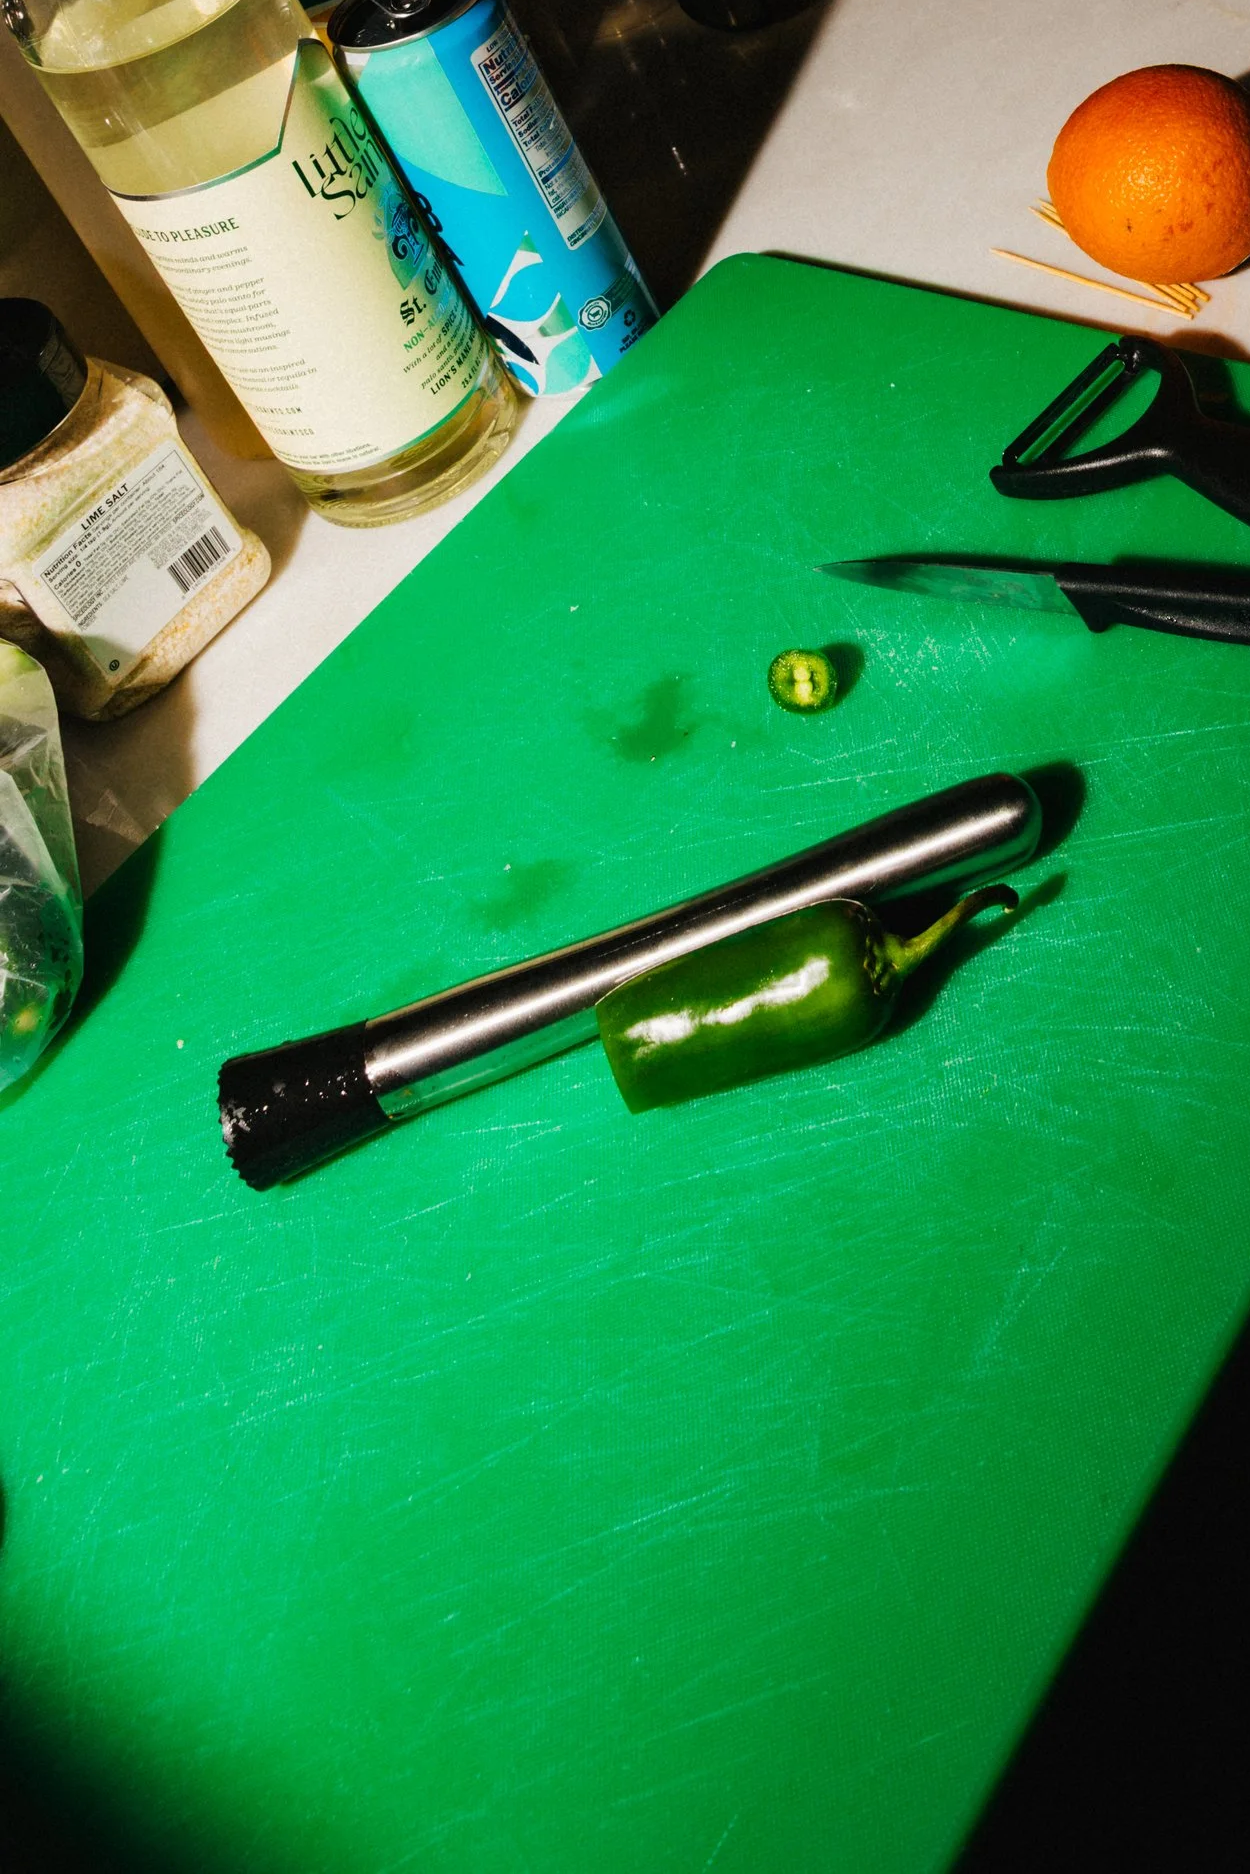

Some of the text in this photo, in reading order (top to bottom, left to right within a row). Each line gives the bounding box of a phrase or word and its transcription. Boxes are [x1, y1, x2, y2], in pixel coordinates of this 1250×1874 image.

[512, 110, 530, 127] Total
[523, 131, 540, 148] Total
[291, 106, 367, 200] Little
[154, 231, 170, 243] TO
[170, 217, 240, 243] PLEASURE
[199, 254, 216, 262] and
[217, 246, 248, 259] warms
[217, 285, 233, 293] and
[235, 277, 264, 291] pepper
[228, 293, 251, 303] santo
[252, 288, 266, 299] for
[248, 299, 272, 311] parts
[400, 295, 427, 327] St.
[246, 308, 279, 322] Infused
[254, 328, 291, 343] musings
[403, 357, 422, 374] With
[427, 342, 436, 354] lot
[441, 310, 457, 336] SPICE
[270, 358, 306, 372] inspired
[430, 365, 457, 395] LION'S
[456, 342, 472, 368] MANE
[276, 371, 307, 382] tequila
[421, 372, 437, 389] palo
[461, 373, 473, 388] 25.4
[80, 482, 130, 530] LIME SALT
[43, 548, 73, 578] Nutrition
[72, 530, 92, 550] Facts
[47, 563, 68, 583] Serving
[53, 567, 77, 590] Calories
[74, 559, 82, 567] 0
